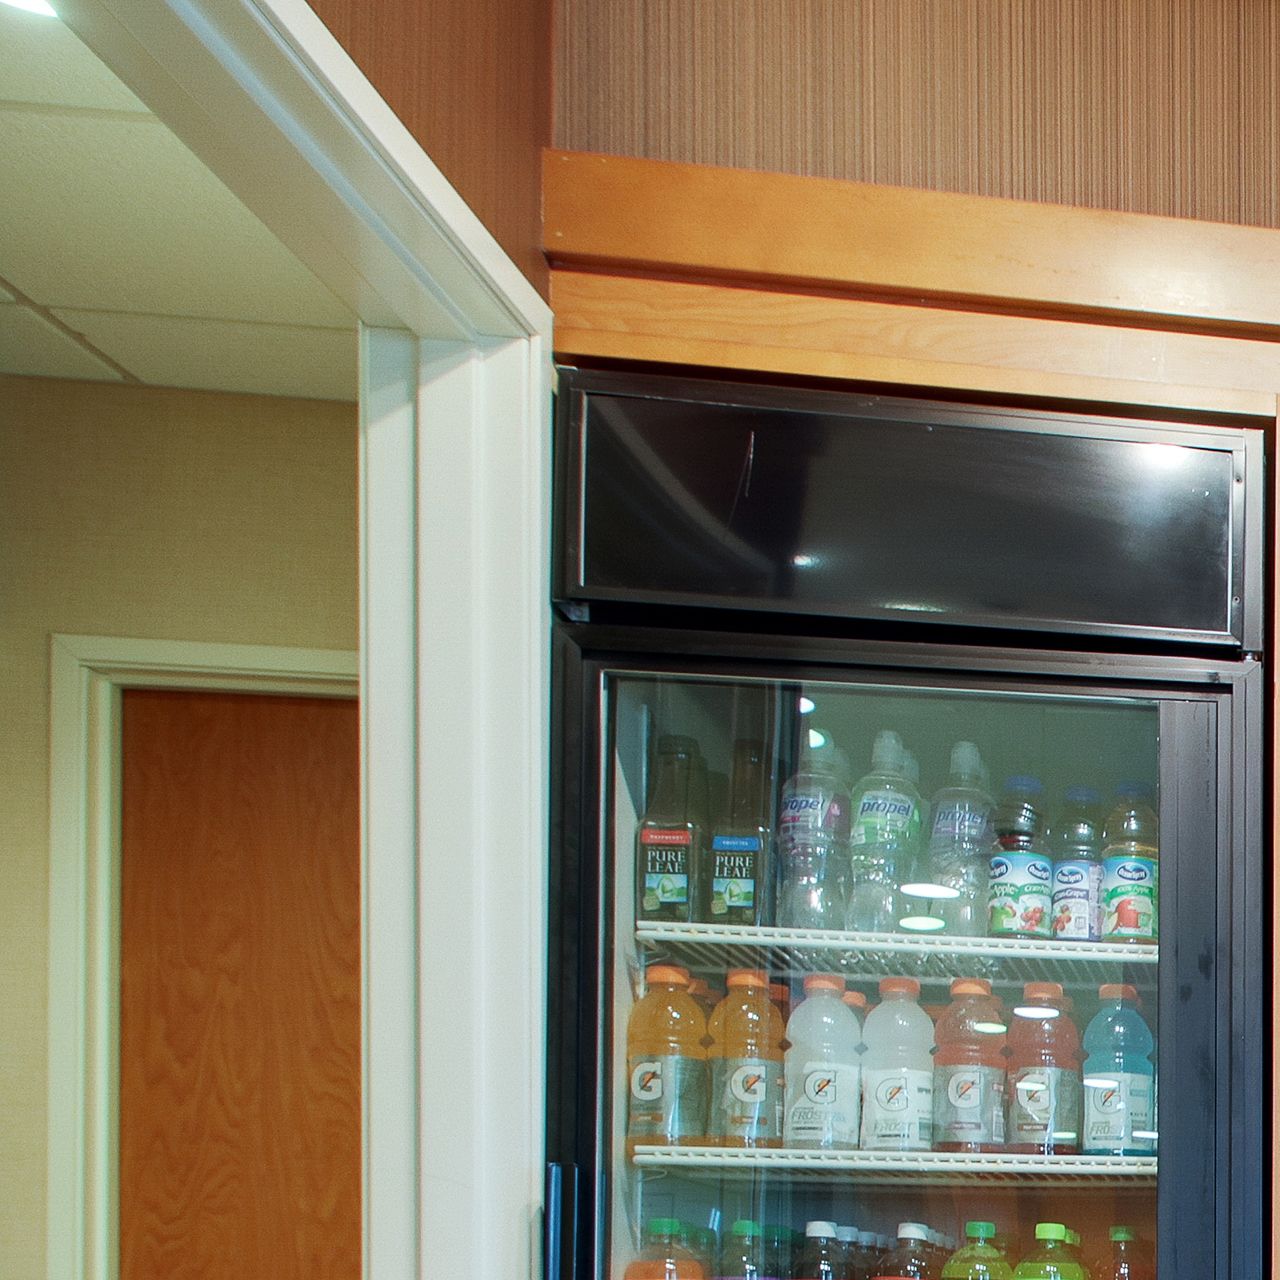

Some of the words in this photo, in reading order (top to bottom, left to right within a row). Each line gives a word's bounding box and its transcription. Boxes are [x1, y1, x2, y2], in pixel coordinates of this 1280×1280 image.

[860, 800, 911, 816] propel
[938, 810, 988, 825] propel
[647, 850, 686, 862] PURE
[715, 855, 754, 867] PURE
